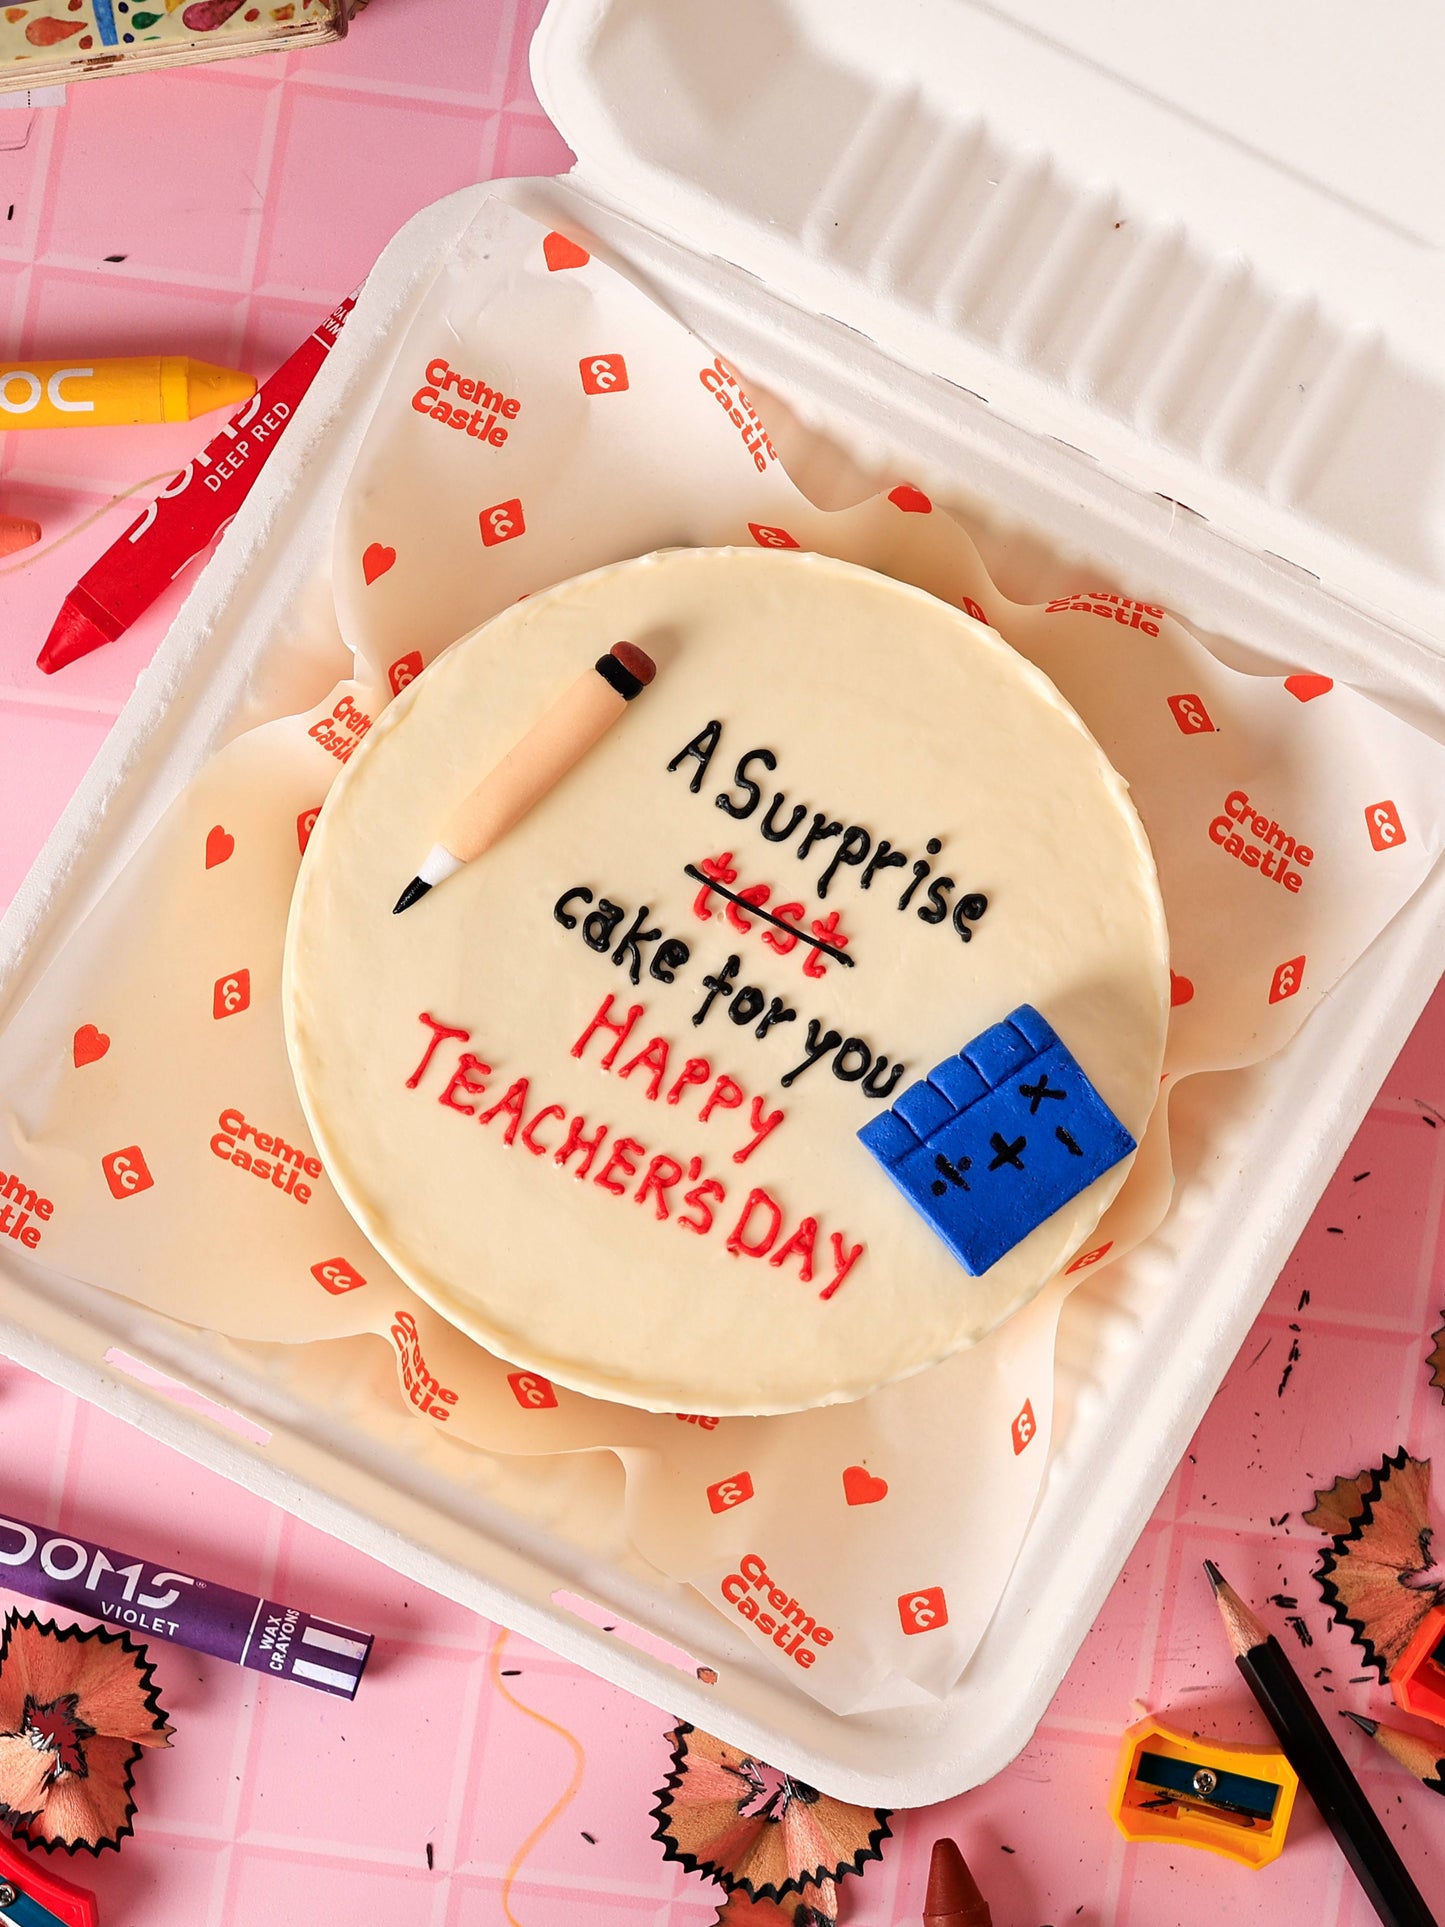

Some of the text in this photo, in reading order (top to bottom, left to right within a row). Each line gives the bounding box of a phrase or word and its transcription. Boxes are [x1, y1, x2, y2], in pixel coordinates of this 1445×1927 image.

[411, 386, 509, 448] Castle
[425, 358, 521, 420] Creme
[699, 368, 767, 473] Castle
[203, 440, 250, 493] DEEP
[250, 401, 291, 443] RED
[1045, 602, 1160, 637] Castle
[333, 696, 373, 739] Crem
[666, 719, 989, 943] A Surprise
[1208, 815, 1303, 894] Castle
[1224, 790, 1315, 867] Creme
[693, 852, 851, 979] test
[553, 886, 905, 1099] cake for you
[570, 993, 785, 1165] HAPPY
[210, 1133, 313, 1205] Castle
[218, 1108, 323, 1180] Creme
[404, 1011, 864, 1301] TEACHER'S DAY
[391, 1325, 450, 1421] Castle
[395, 1311, 459, 1405] Creme
[100, 1600, 180, 1637] VIOLET
[259, 1615, 282, 1649] WAX
[269, 1608, 300, 1671] CRAYONS
[721, 1574, 816, 1670] Castle
[739, 1553, 834, 1648] Creme
